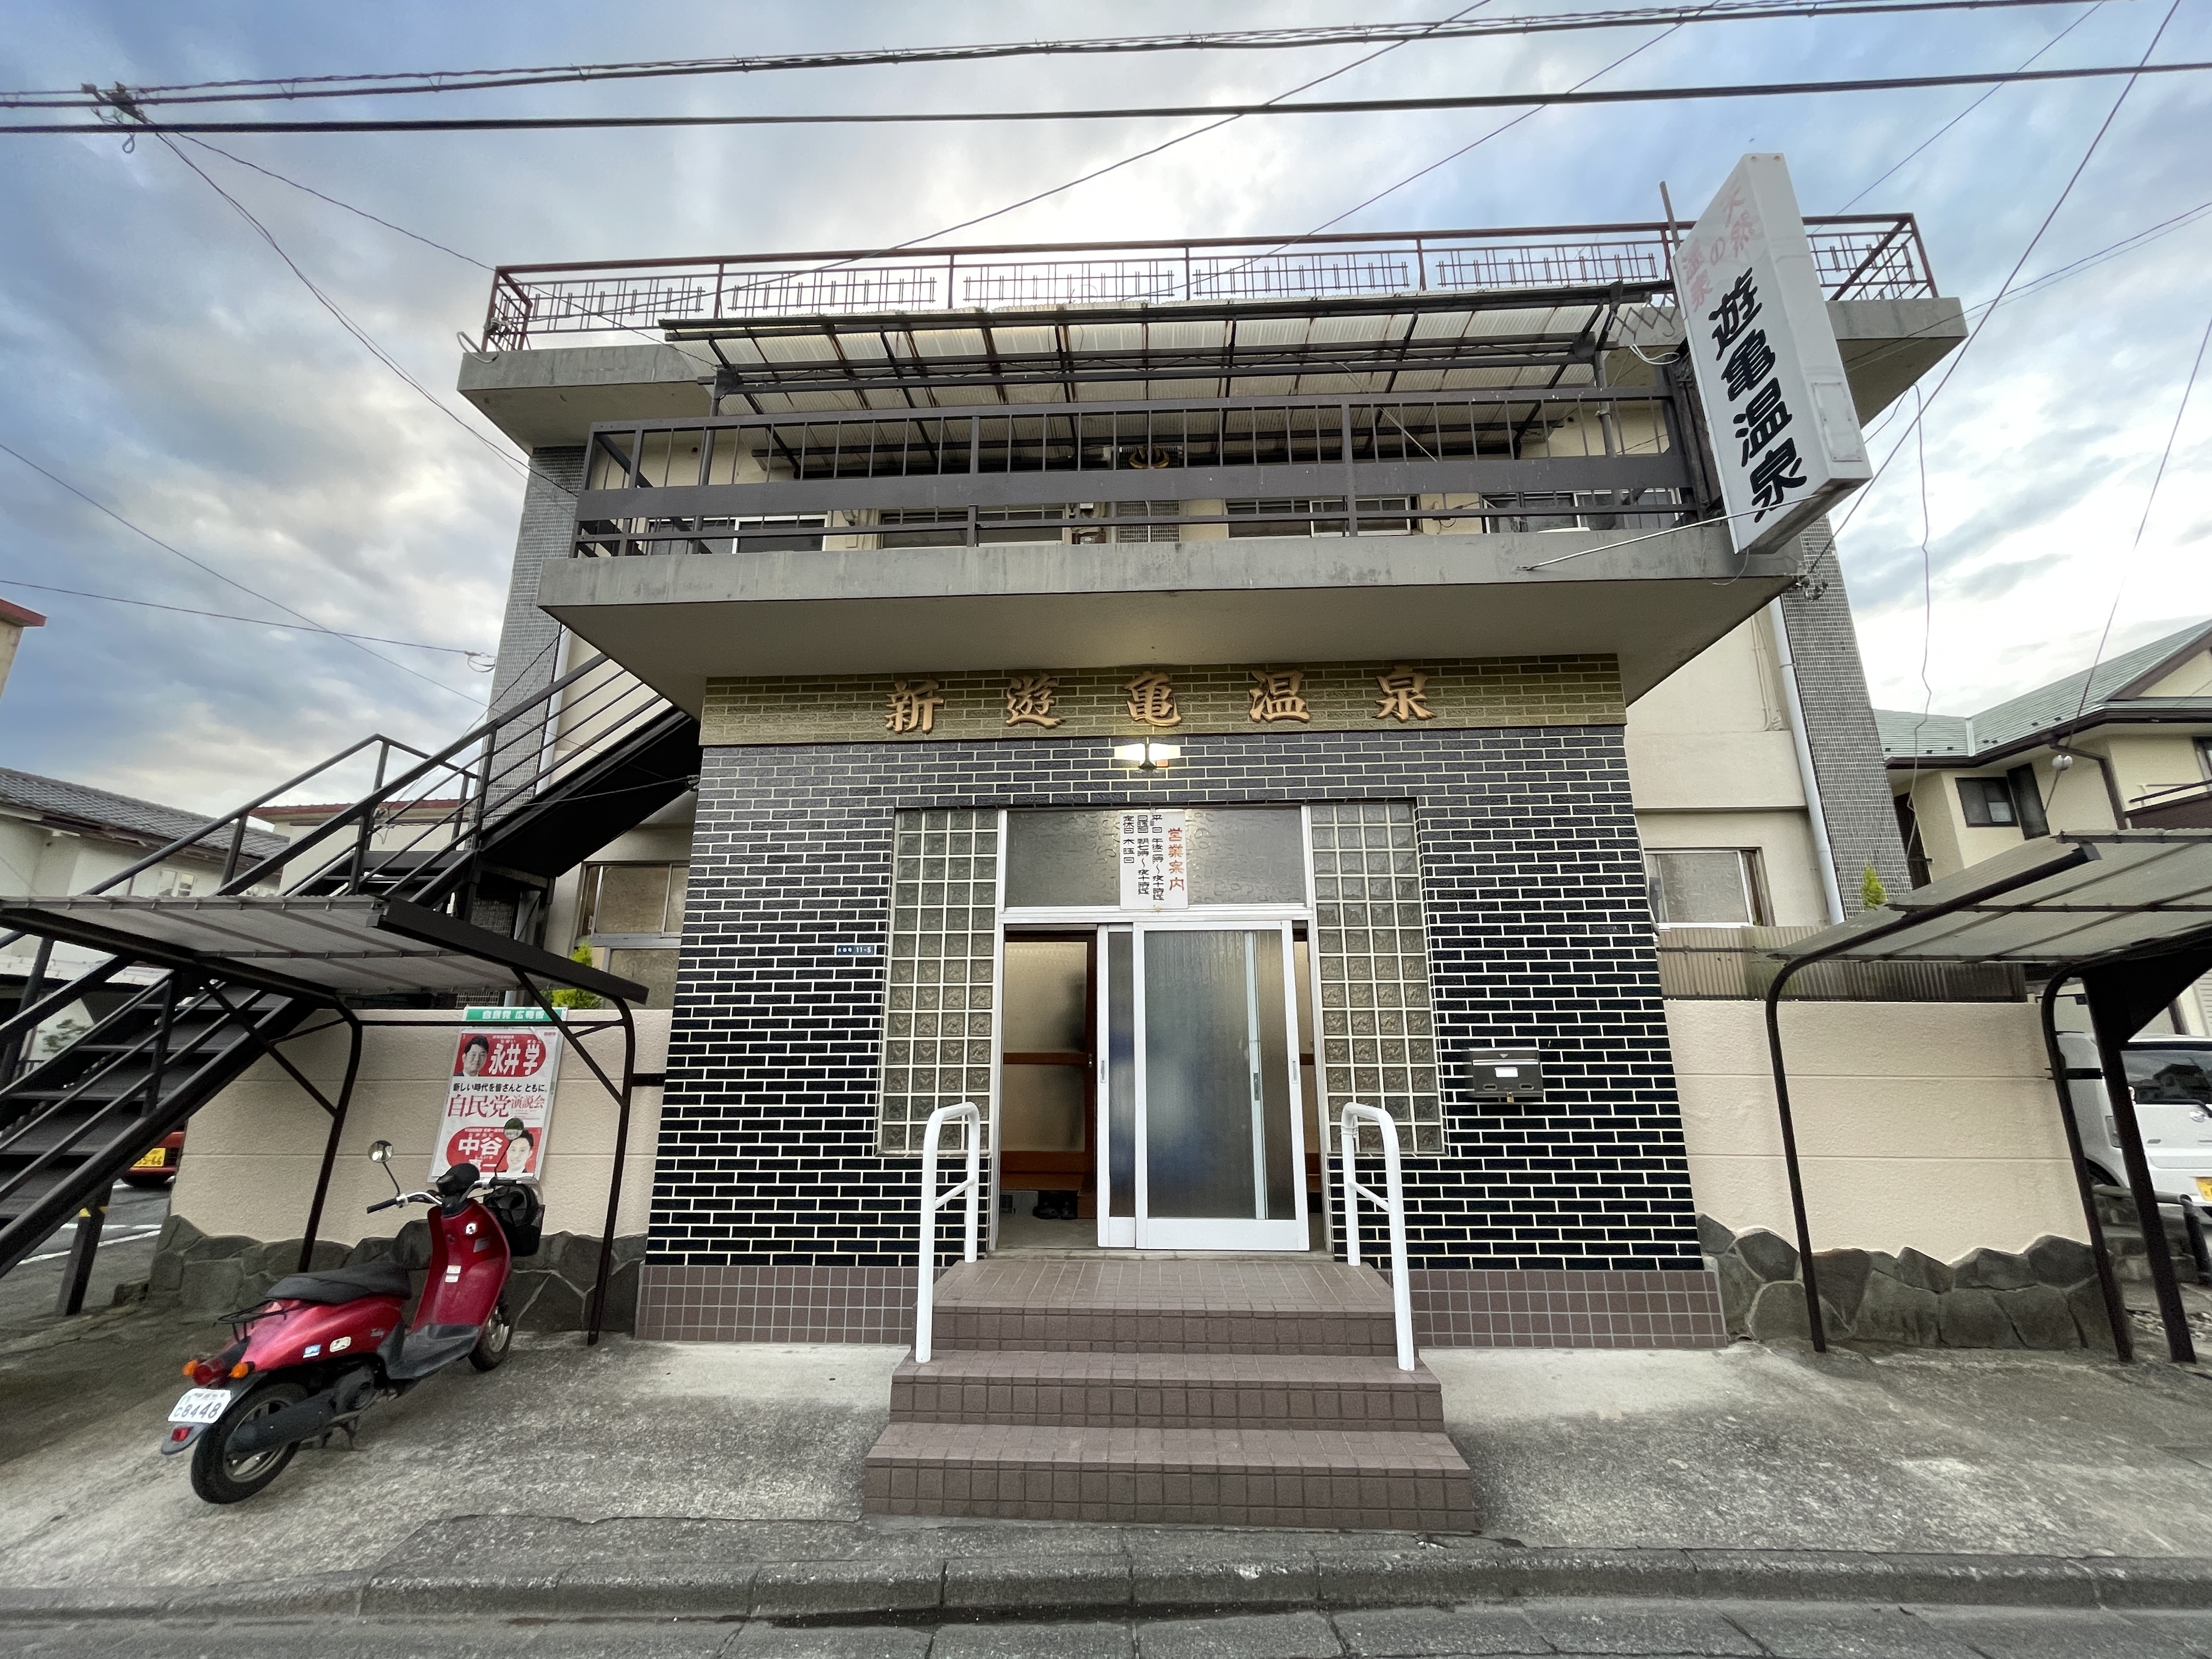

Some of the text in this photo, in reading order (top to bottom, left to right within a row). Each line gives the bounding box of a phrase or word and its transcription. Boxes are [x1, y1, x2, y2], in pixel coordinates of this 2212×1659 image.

[1708, 266, 1807, 523] 遊亀温泉
[885, 665, 1438, 735] 新遊亀温泉
[1167, 827, 1185, 891] 営業案内
[488, 1043, 540, 1075] 永井 学
[447, 1093, 511, 1118] 自民党
[511, 1094, 545, 1109] 演説会
[458, 1137, 503, 1155] 中谷
